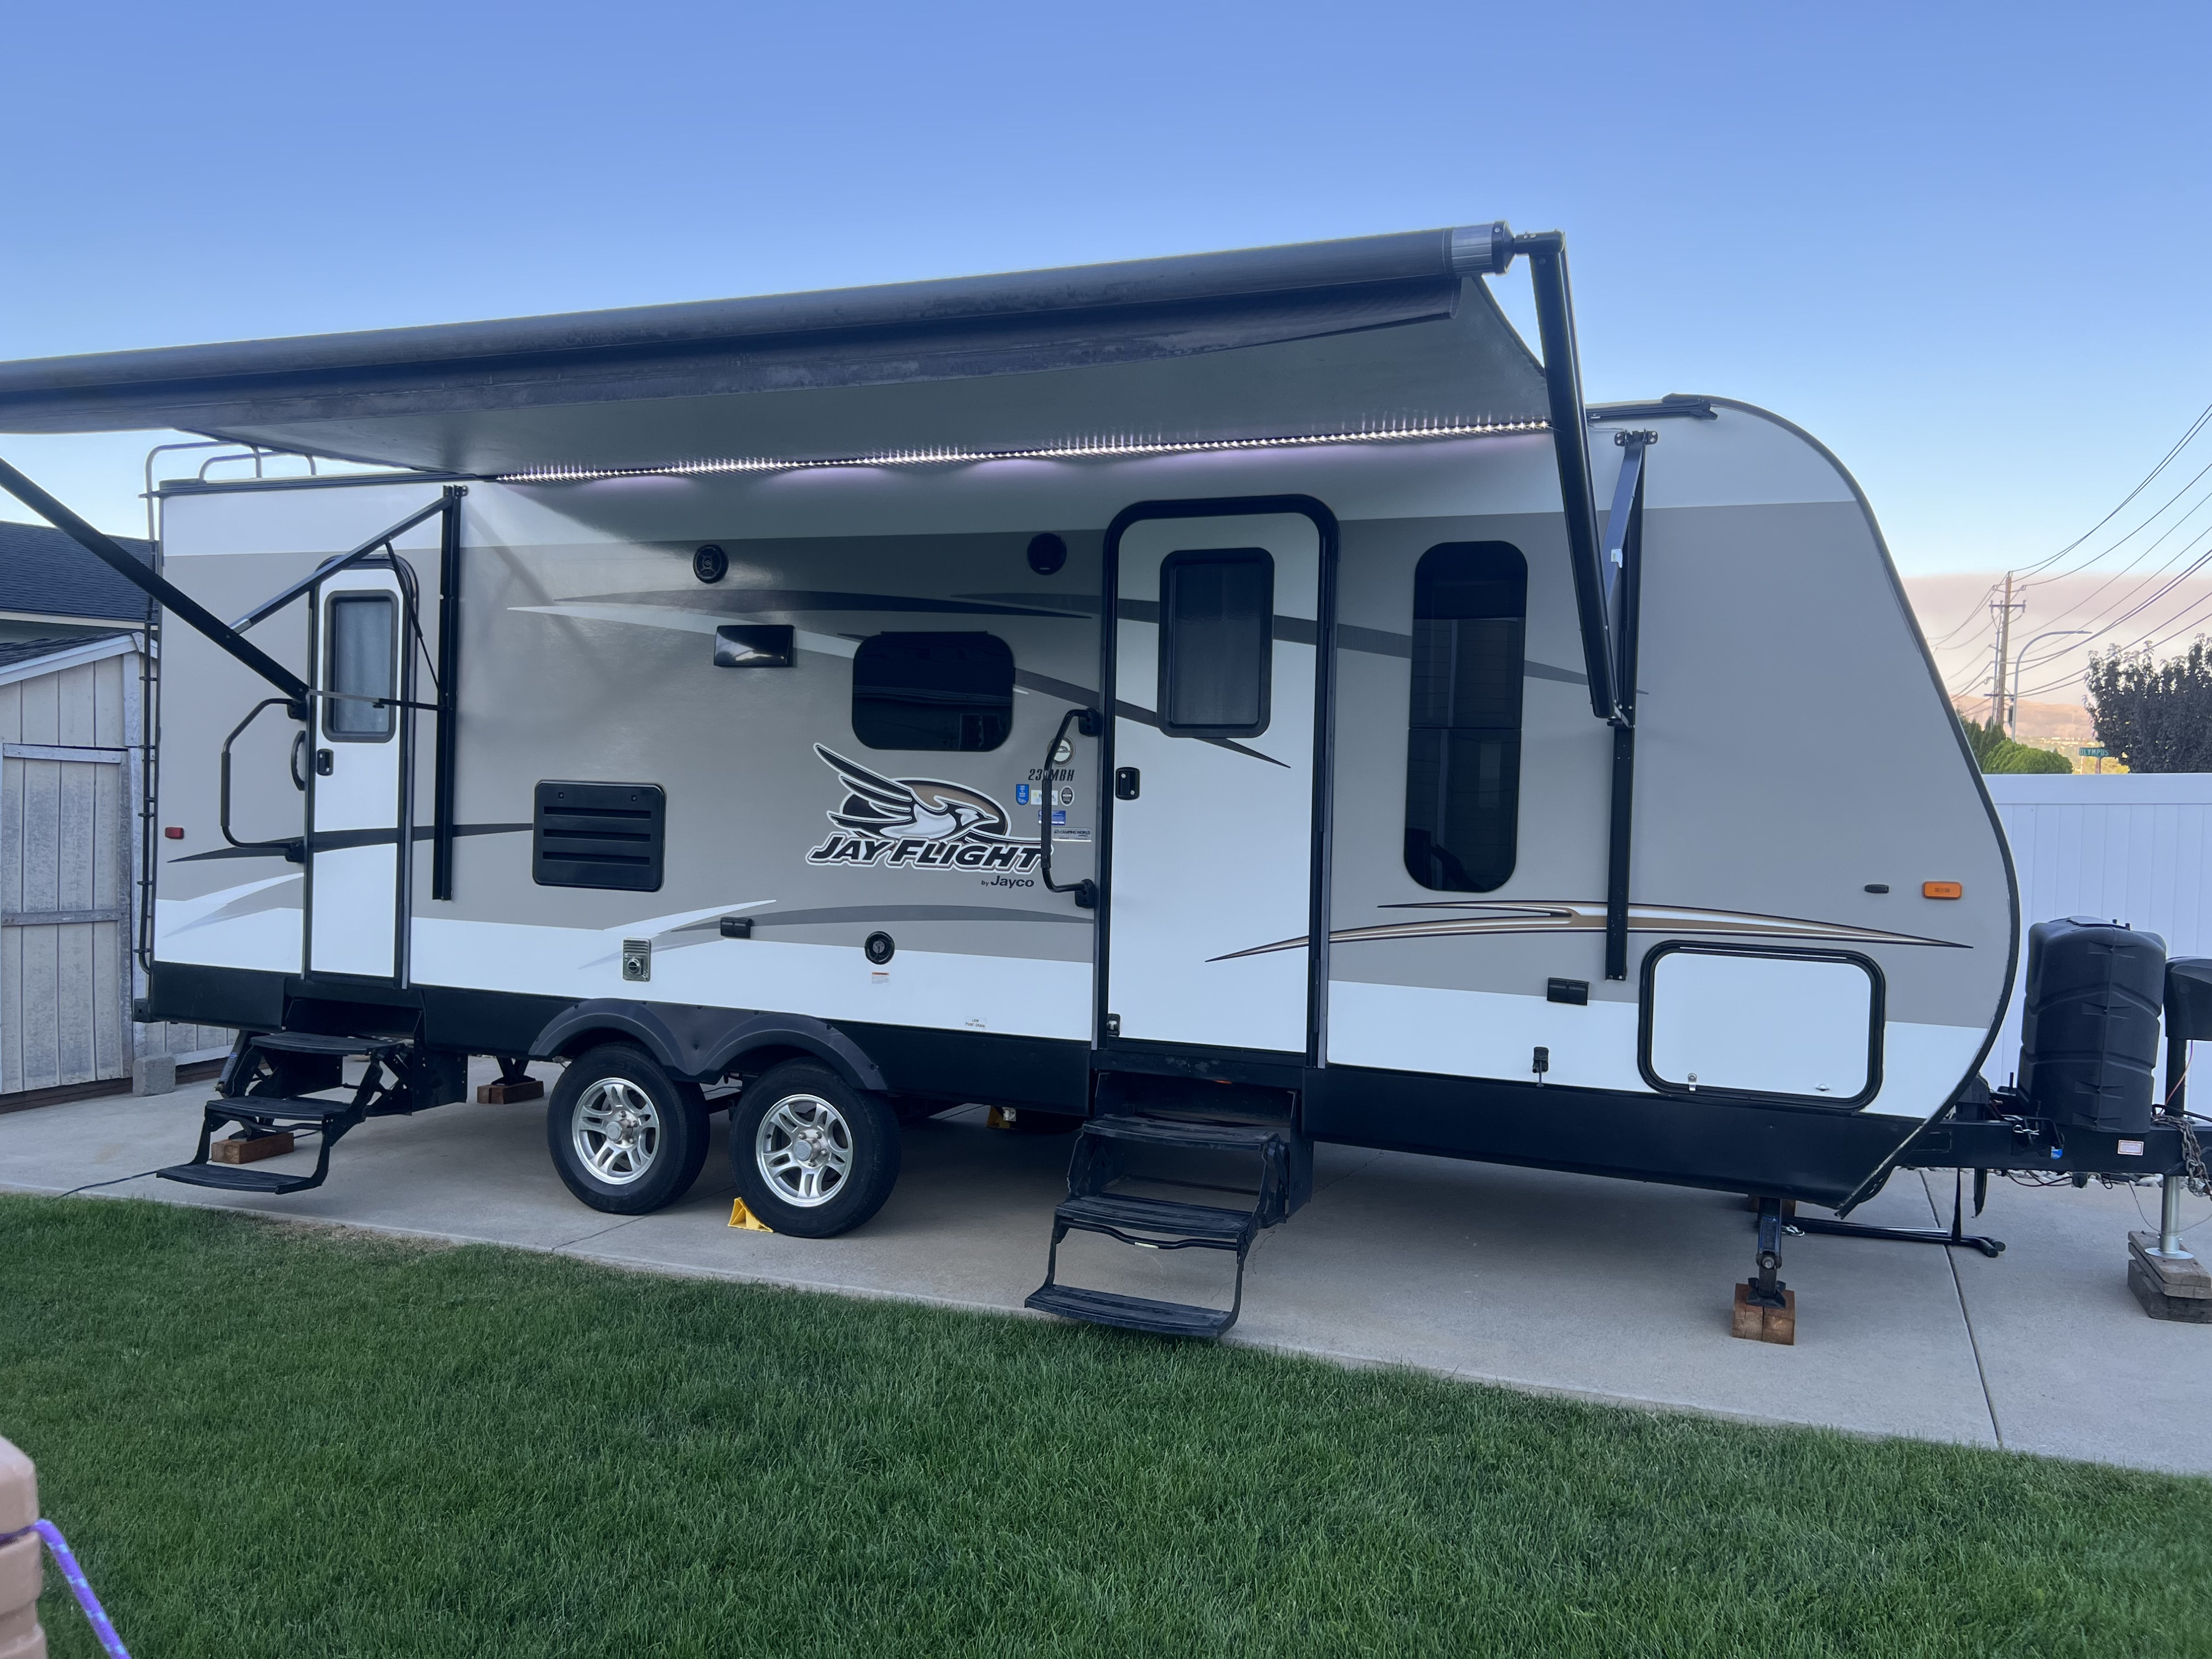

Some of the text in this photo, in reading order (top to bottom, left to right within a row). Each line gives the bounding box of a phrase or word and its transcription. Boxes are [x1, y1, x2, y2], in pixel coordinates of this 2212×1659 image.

[2079, 748, 2109, 757] OLYMPUS
[809, 836, 1042, 869] JAY FLIGHT
[990, 875, 1035, 889] Jayco
